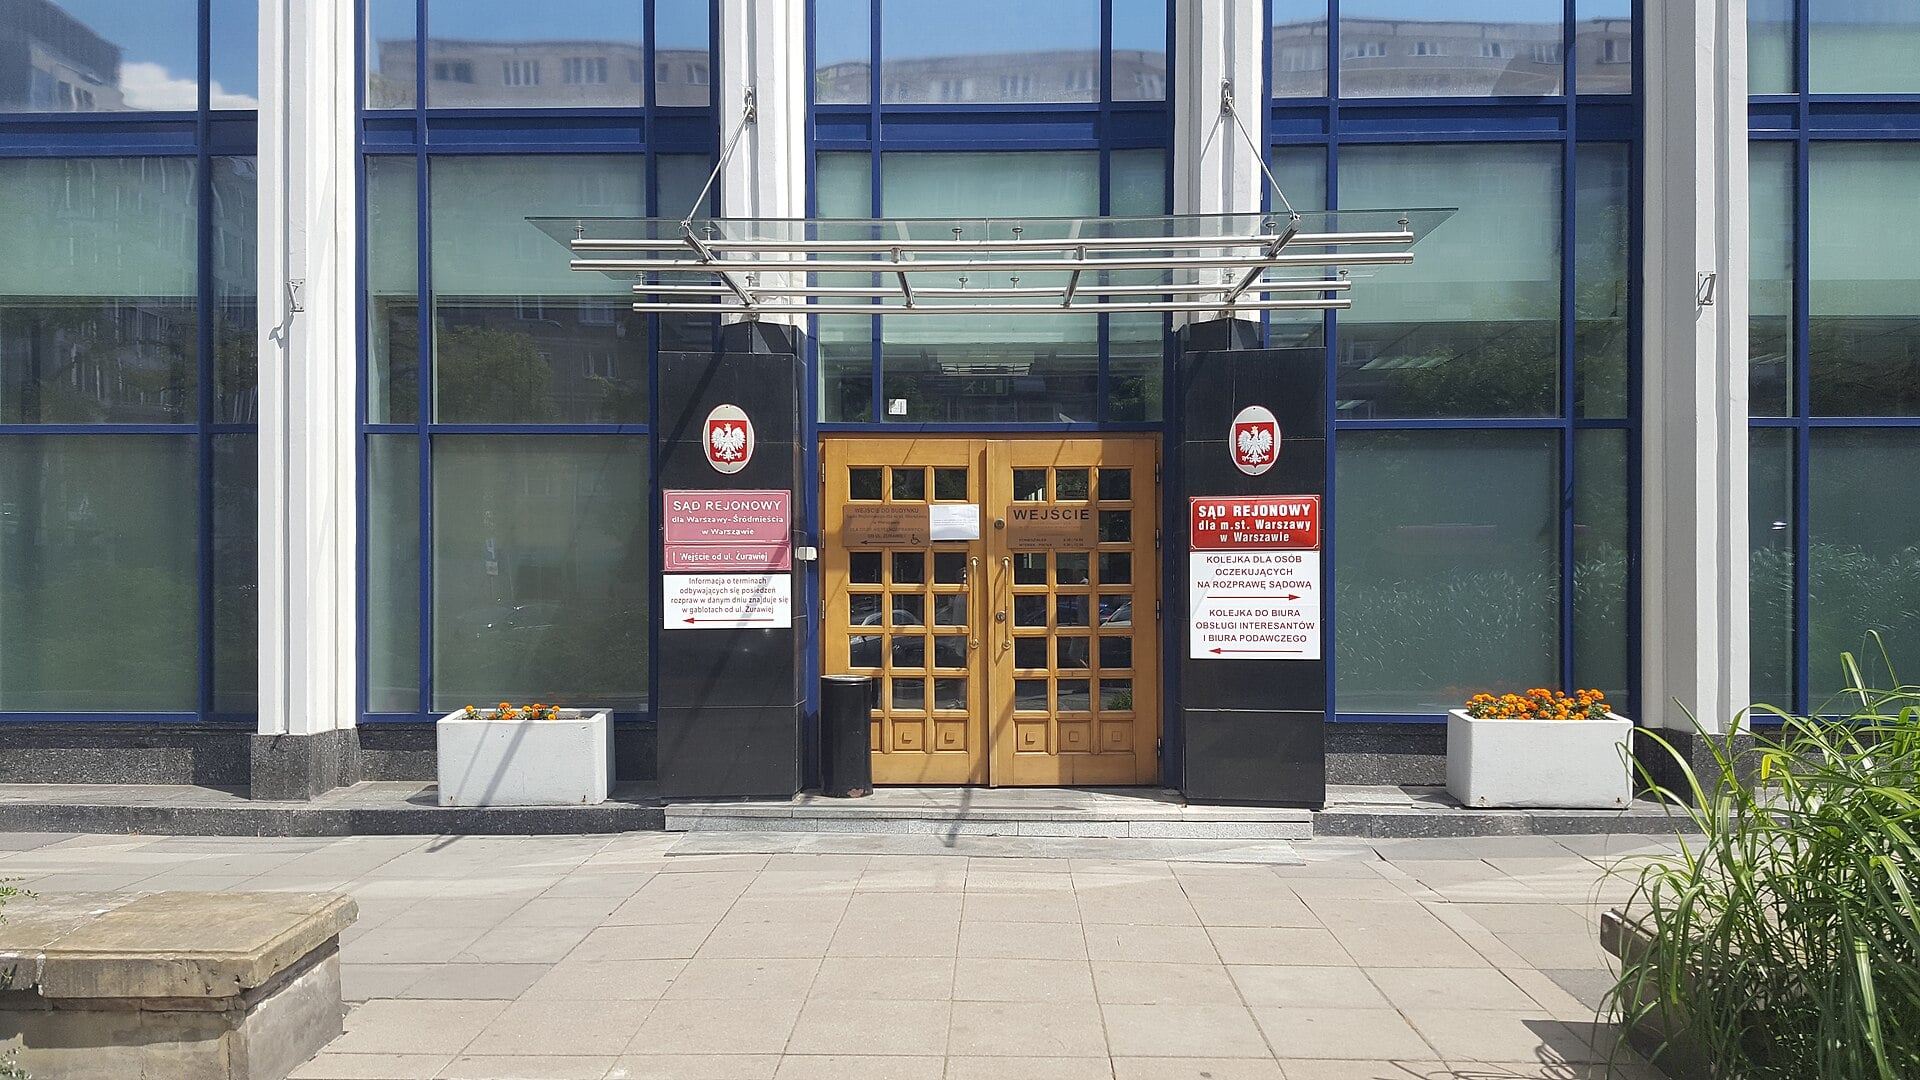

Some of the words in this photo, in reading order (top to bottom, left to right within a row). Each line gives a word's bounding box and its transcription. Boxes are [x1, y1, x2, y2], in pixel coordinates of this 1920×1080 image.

[673, 501, 700, 513] SĄD
[705, 500, 781, 511] REJONOWY
[1012, 506, 1090, 520] WEJŚCIE
[1198, 505, 1226, 520] SĄD
[1234, 504, 1311, 517] REJONOWY
[1198, 520, 1216, 530] dla
[1220, 520, 1250, 530] m.st.
[1255, 519, 1311, 532] Warszawy
[1220, 534, 1228, 542] w
[1234, 532, 1290, 542] Warszawie
[680, 552, 710, 562] Wejście
[712, 552, 722, 560] od
[724, 552, 733, 560] ul.
[736, 550, 768, 562] Żurawiej
[1253, 556, 1272, 564] DLA
[1275, 554, 1302, 564] OSÓB
[1216, 568, 1293, 578] OCZEKUJĄCYCH
[688, 578, 725, 586] Informacja
[1213, 580, 1266, 590] ROZPRAWĘ
[1269, 580, 1312, 590] SĄDOWĄ
[680, 587, 728, 595] odbywających
[708, 596, 730, 604] danym
[748, 596, 776, 604] znajduje
[778, 596, 789, 604] się
[690, 606, 722, 614] gablotach
[1210, 609, 1252, 617] KOLEJKA
[1255, 609, 1268, 617] DO
[1272, 609, 1300, 617] BIURA
[1196, 622, 1236, 630] OBSŁUGI
[1240, 620, 1315, 630] INTERESANTÓW
[1240, 634, 1307, 642] PODAWCZEGO
